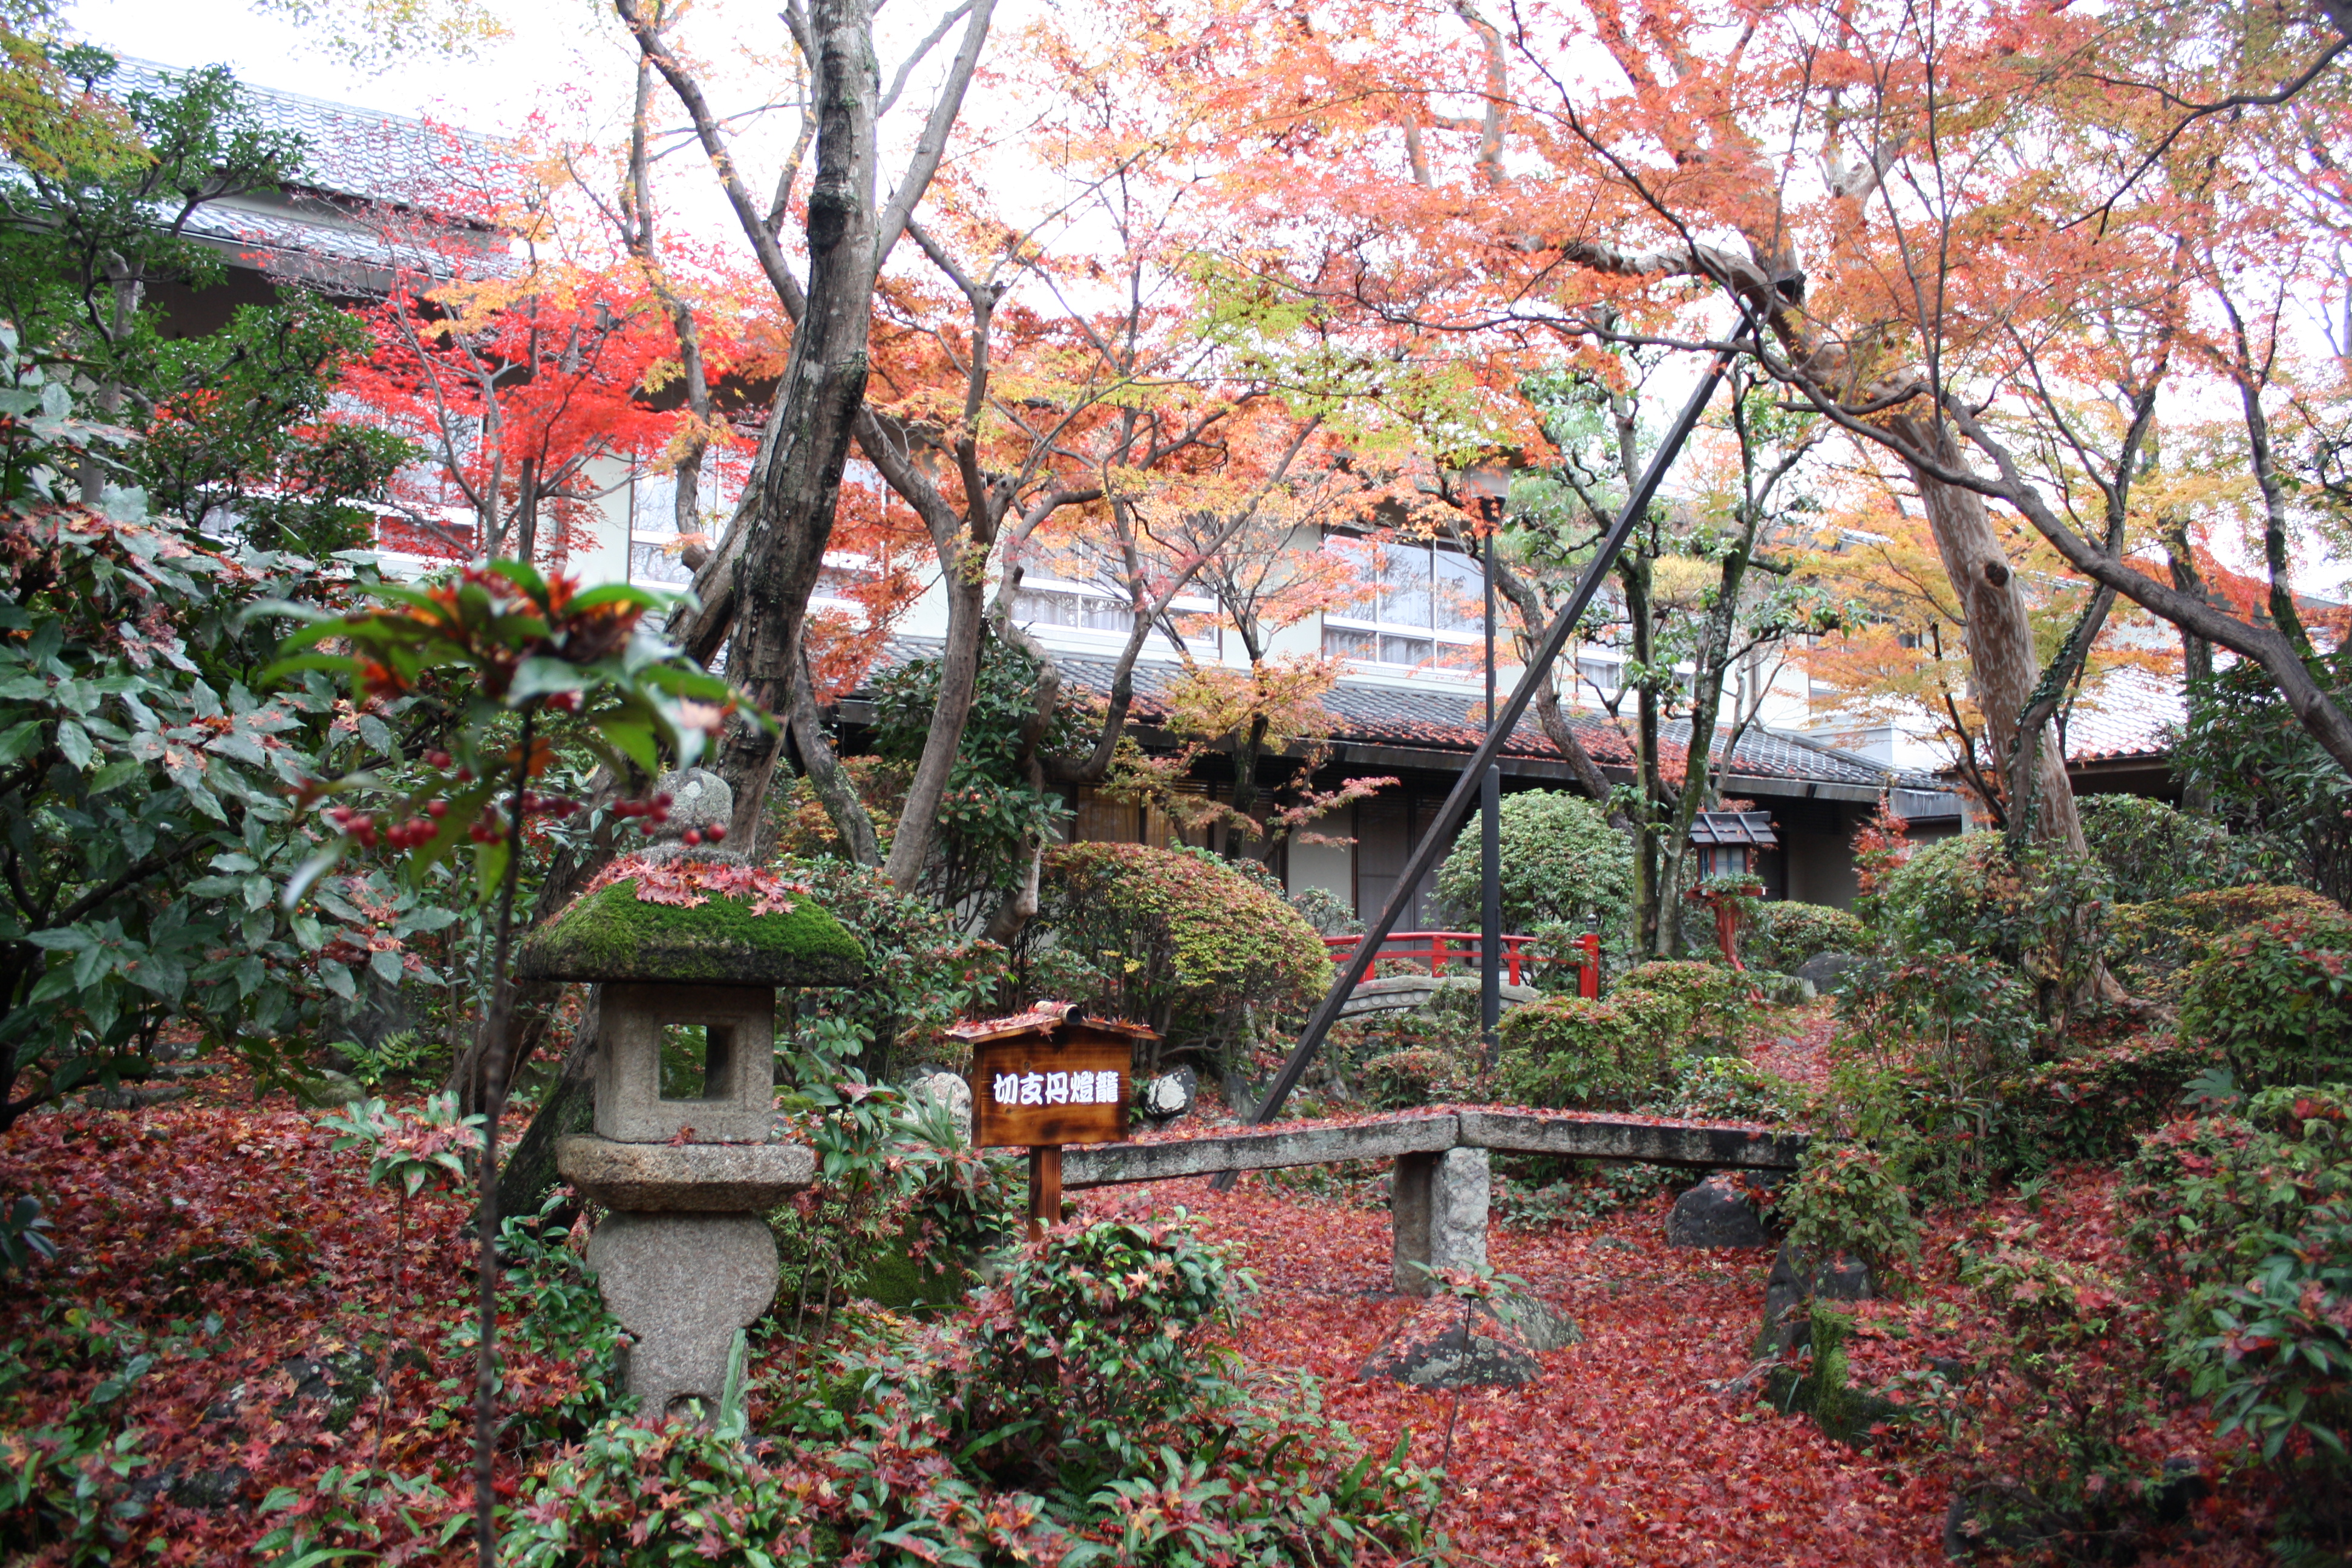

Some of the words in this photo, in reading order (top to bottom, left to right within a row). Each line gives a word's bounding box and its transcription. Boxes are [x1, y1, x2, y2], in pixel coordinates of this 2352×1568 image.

[993, 1071, 1119, 1105] 切支丹燈籠
